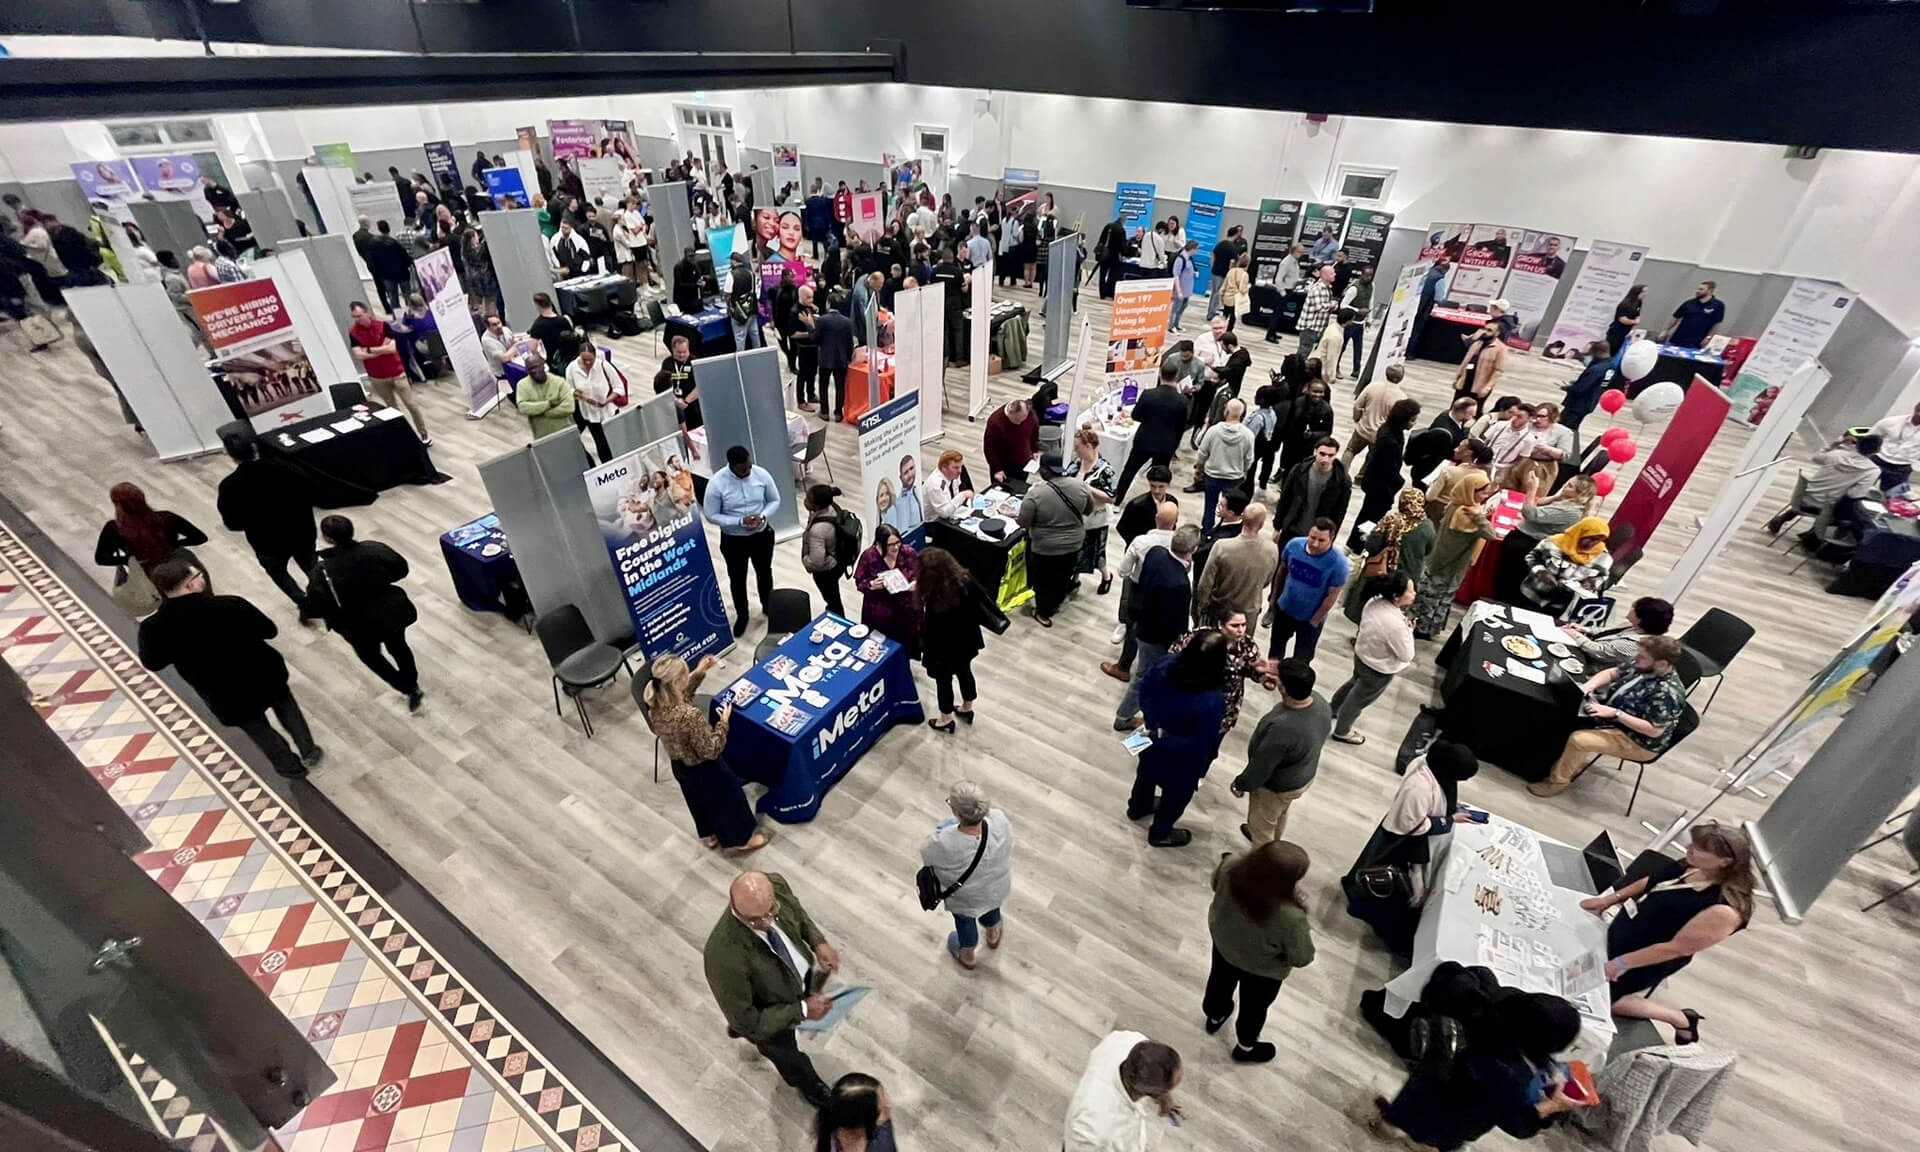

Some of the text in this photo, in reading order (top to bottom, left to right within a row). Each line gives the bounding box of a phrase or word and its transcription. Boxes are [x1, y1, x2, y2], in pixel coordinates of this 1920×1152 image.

[1465, 248, 1492, 258] GROW
[1516, 254, 1542, 264] GROW
[1464, 257, 1498, 268] WITH US
[1514, 262, 1546, 274] WITH US
[202, 295, 277, 323] WE'RE HIRING
[1117, 296, 1136, 304] Over
[207, 304, 280, 332] DRIVERS AND
[1115, 304, 1168, 315] Unemployed?
[211, 315, 275, 340] MECHANICS
[1112, 324, 1162, 336] Birmingham?
[1114, 317, 1138, 326] Living
[616, 512, 694, 562] Free Digital
[620, 537, 676, 573] Courses
[640, 558, 662, 577] the
[663, 538, 697, 562] West
[628, 558, 688, 597] Midlands
[811, 678, 886, 761] iMeta
